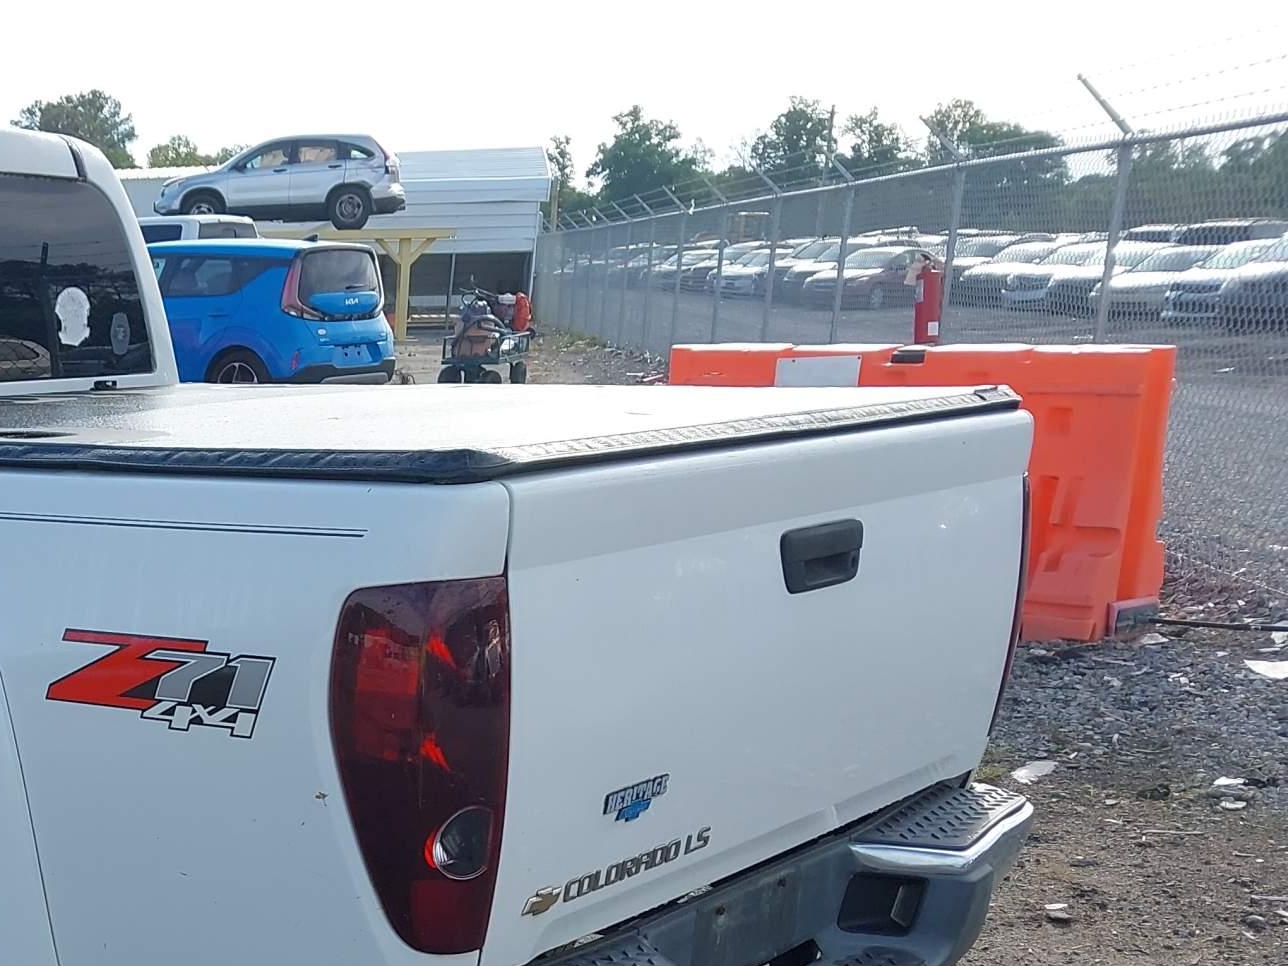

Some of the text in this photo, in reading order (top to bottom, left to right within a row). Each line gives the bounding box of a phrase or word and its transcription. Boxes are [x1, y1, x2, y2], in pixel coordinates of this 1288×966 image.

[46, 628, 277, 710] Z71
[604, 773, 670, 814] HERITAGE
[563, 827, 712, 903] COLORADO LS
